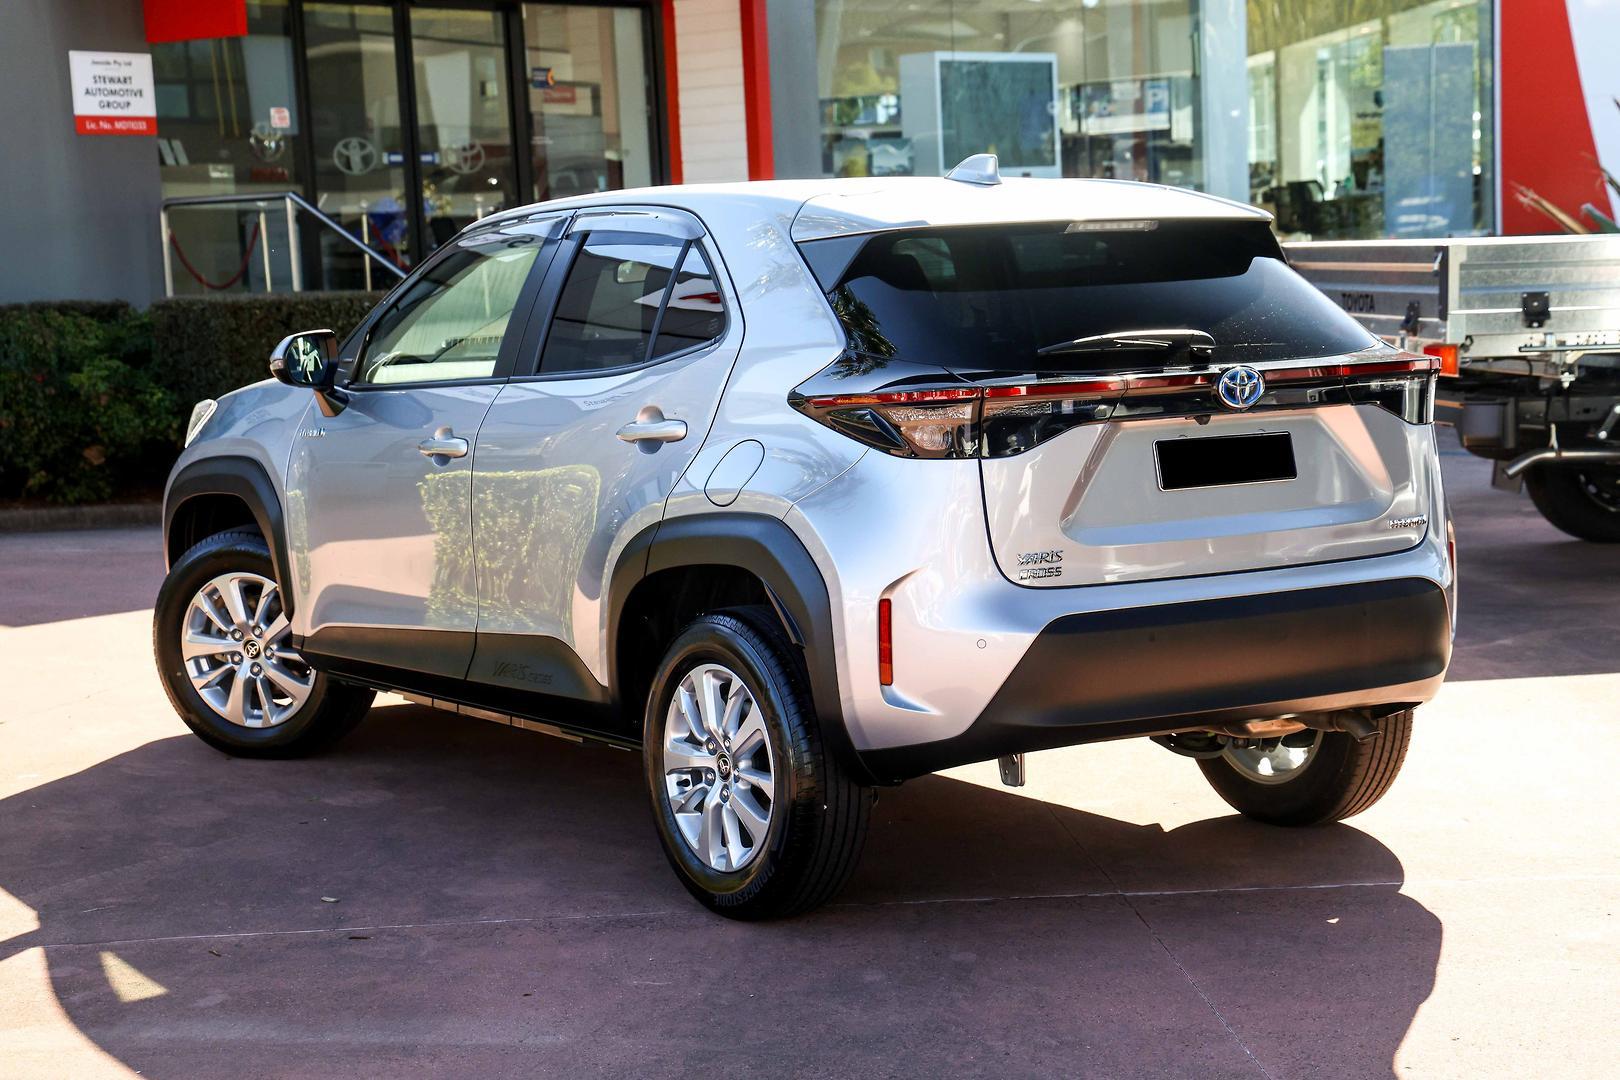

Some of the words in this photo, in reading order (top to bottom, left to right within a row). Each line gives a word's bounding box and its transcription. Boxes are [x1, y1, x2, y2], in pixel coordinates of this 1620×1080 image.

[93, 75, 133, 85] STEWART
[84, 87, 144, 98] AUTOMOTIVE
[98, 99, 132, 110] GROUP
[1341, 292, 1376, 312] TOYOTA
[1018, 566, 1062, 580] CROSS
